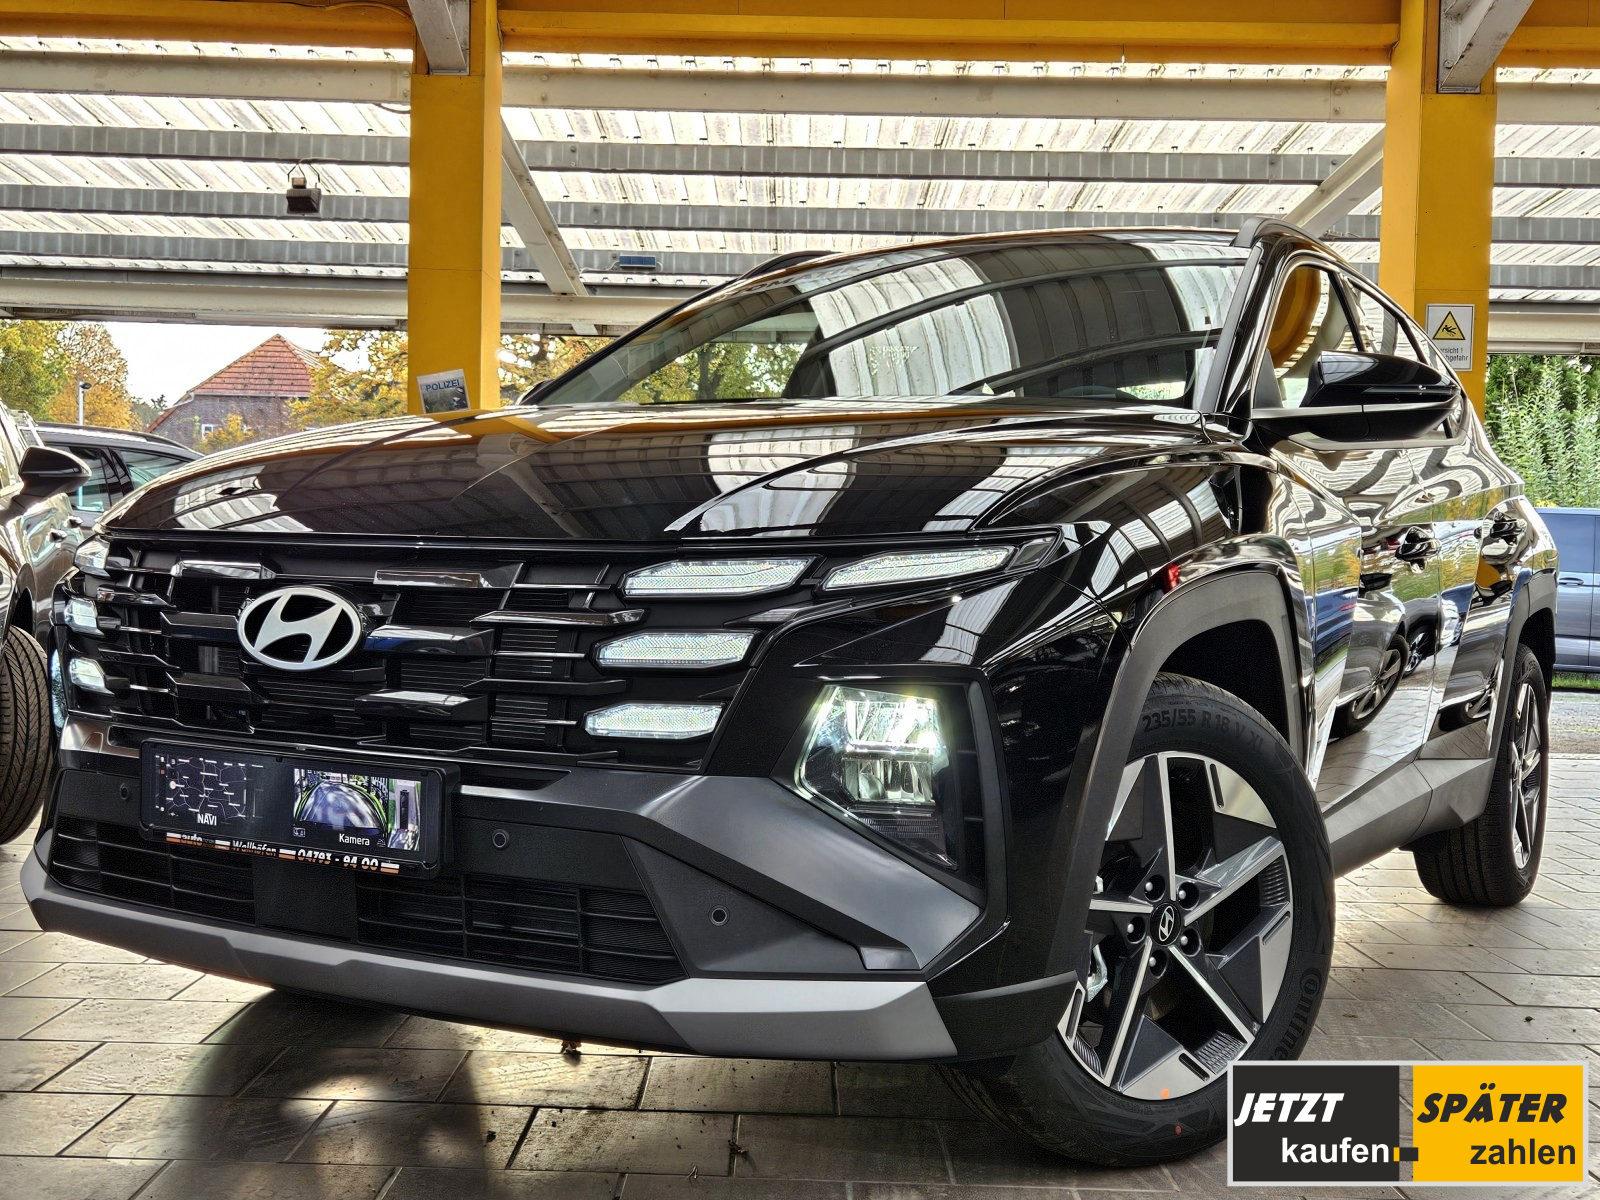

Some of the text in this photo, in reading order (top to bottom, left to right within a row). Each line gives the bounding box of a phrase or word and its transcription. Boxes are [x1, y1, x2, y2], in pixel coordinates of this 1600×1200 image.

[425, 379, 460, 391] POLIZEI
[1142, 708, 1196, 733] 235/55
[1201, 710, 1212, 729] R
[197, 813, 217, 826] NAVI
[338, 833, 371, 847] Kamera
